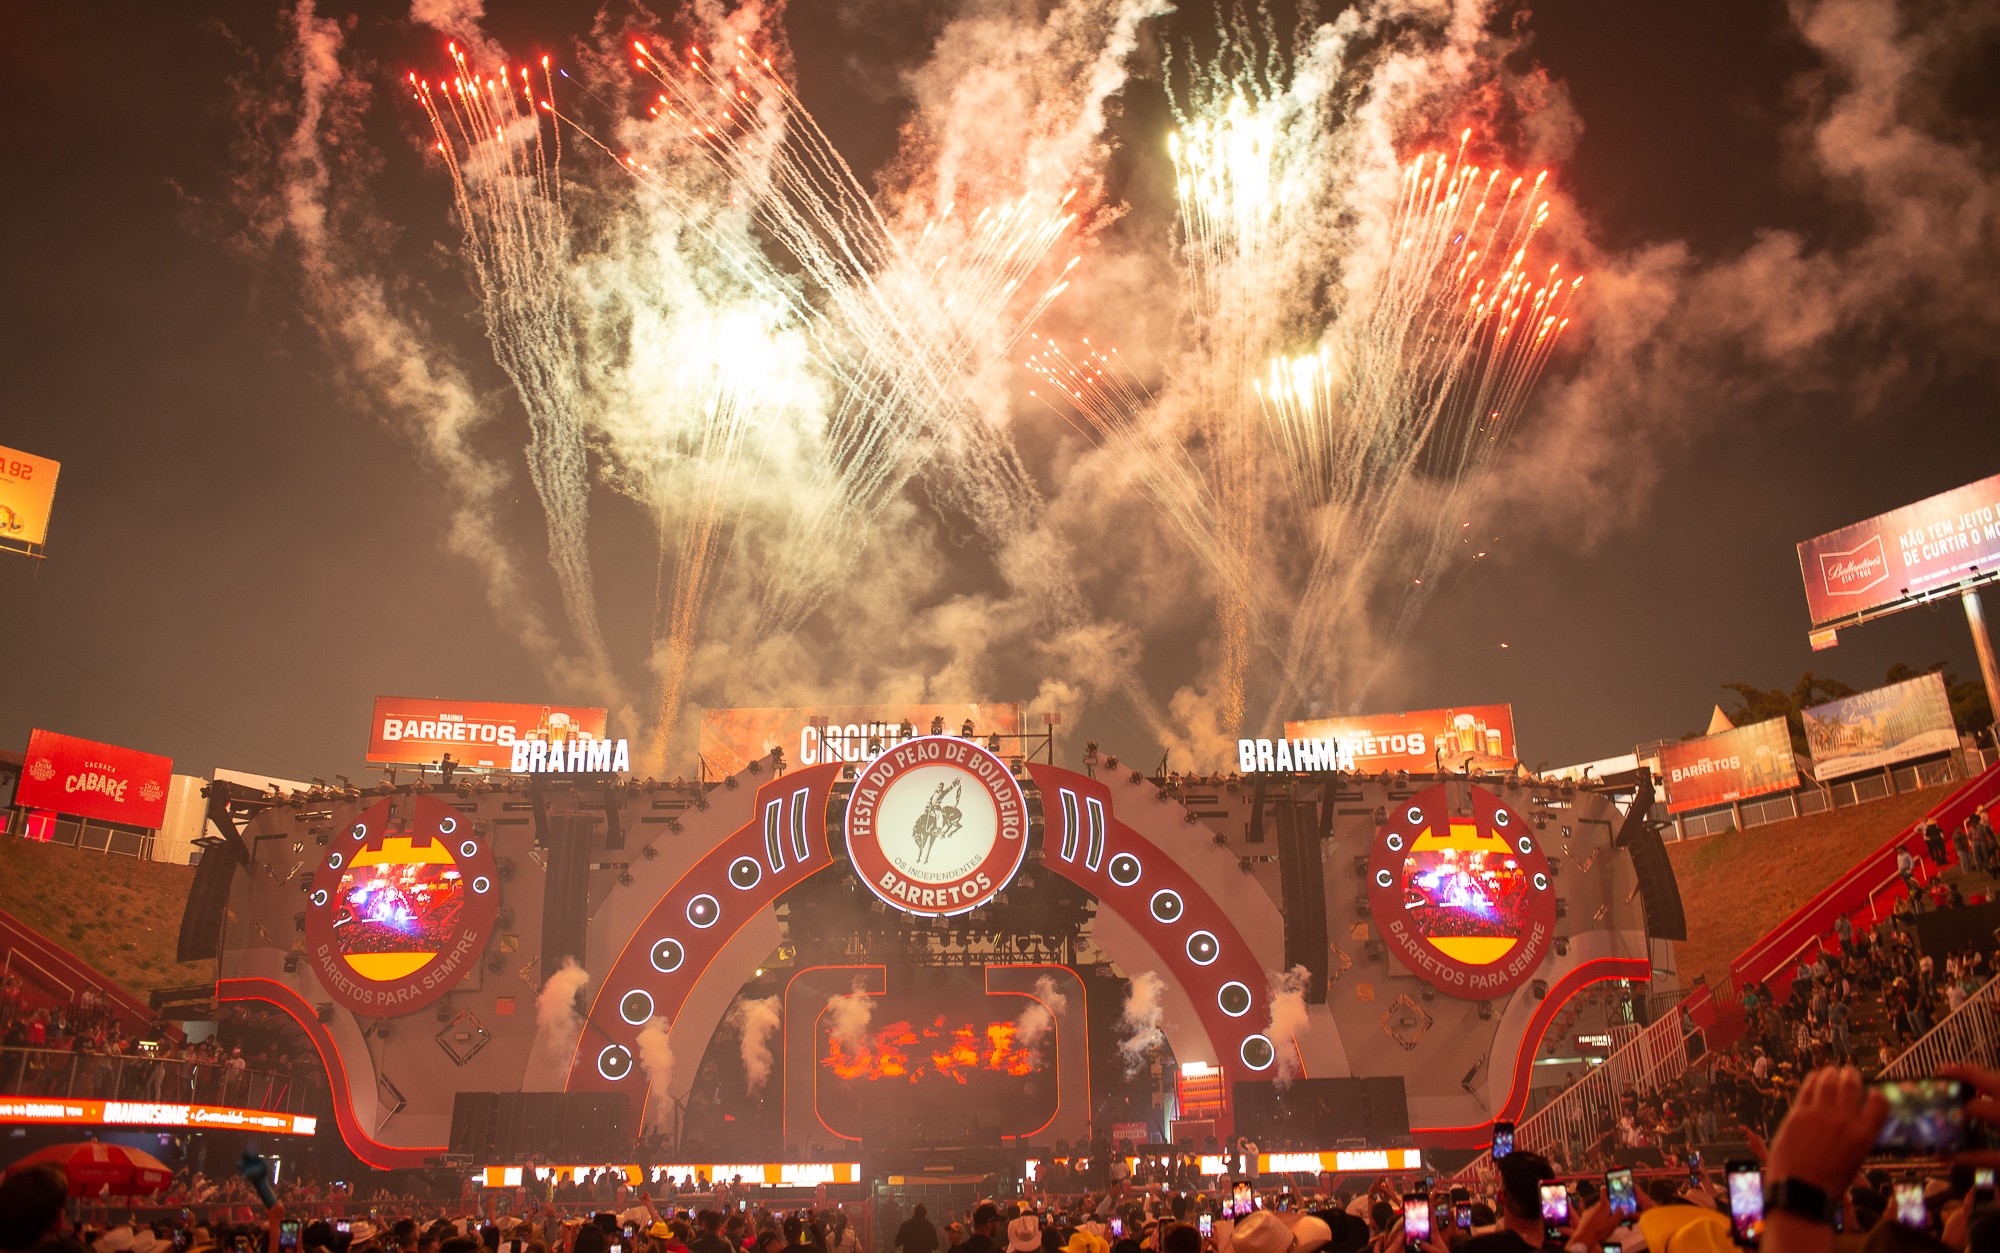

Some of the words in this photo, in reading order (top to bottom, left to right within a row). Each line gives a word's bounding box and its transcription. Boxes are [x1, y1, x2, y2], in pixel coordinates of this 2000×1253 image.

[9, 461, 33, 481] 92
[1899, 529, 1925, 551] NÃO
[1926, 519, 1954, 541] TEM
[1957, 506, 1993, 532] JEITO
[1903, 548, 1921, 567] DE
[1922, 532, 1969, 561] CURTIR
[1970, 528, 1981, 545] O
[1841, 573, 1856, 584] STAY
[1856, 569, 1872, 581] TRUE
[383, 719, 516, 747] BARRETOS
[439, 713, 464, 722] BRAHMA
[510, 738, 630, 773] BRAHMA
[1238, 738, 1356, 773] BRAHMA
[1671, 756, 1741, 783] BARRETOS
[65, 772, 128, 803] CABARÉ
[853, 788, 878, 836] FESTA
[869, 762, 895, 788] DO
[895, 740, 940, 769] PEÃO
[945, 743, 969, 763] DE
[968, 752, 1020, 840] BOIADEIRO
[894, 857, 907, 870] OS
[907, 854, 982, 881] INDEPENDENTES
[878, 871, 992, 907] BARRETOS
[317, 943, 373, 1005] BARRETOS
[377, 983, 422, 1006] PARA
[422, 928, 478, 990] SEMPRE
[1389, 919, 1465, 986] BARRETOS
[1469, 971, 1508, 989] PARA
[1509, 921, 1545, 977] SEMPRE
